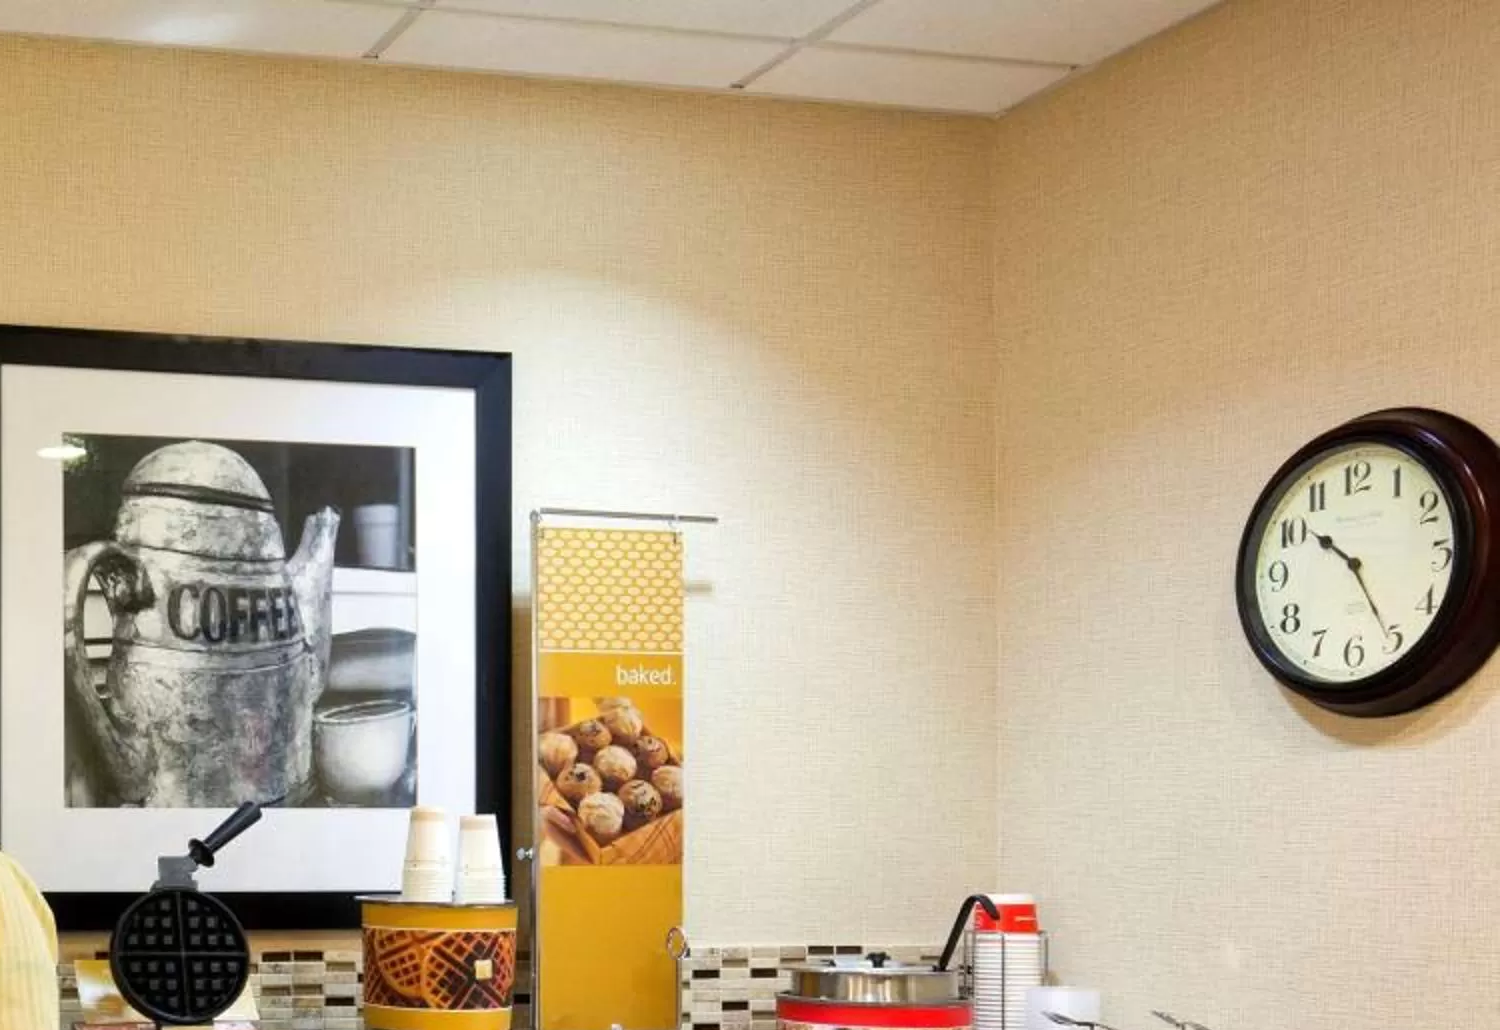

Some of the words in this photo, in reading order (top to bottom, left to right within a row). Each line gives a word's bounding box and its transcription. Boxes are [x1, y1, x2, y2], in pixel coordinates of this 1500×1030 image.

[1344, 460, 1372, 496] 12
[1391, 464, 1401, 498] 1
[1308, 480, 1326, 512] 11
[1419, 491, 1439, 525] 2
[1280, 517, 1307, 549] 10
[1431, 539, 1451, 572] 3
[1268, 559, 1289, 592] 9
[167, 583, 299, 643] COFFEE
[1415, 584, 1438, 615] 4
[1280, 602, 1300, 635] 8
[1311, 629, 1328, 658] 7
[1343, 635, 1365, 668] 6
[1382, 625, 1404, 653] 5
[615, 663, 677, 685] baked.
